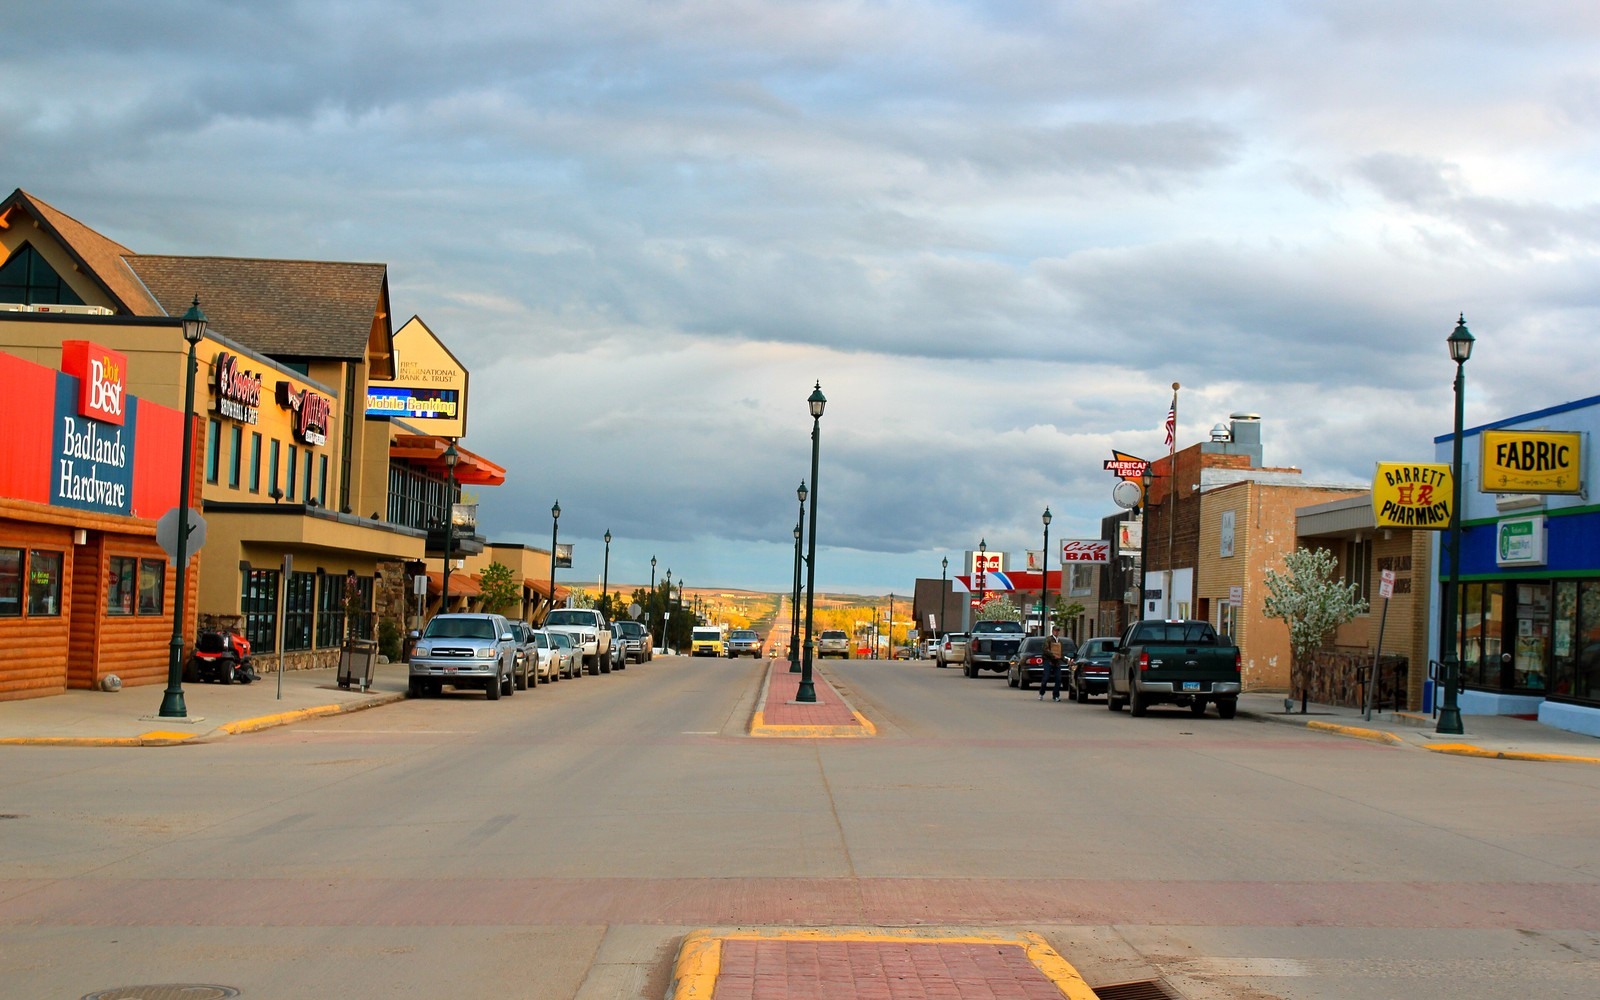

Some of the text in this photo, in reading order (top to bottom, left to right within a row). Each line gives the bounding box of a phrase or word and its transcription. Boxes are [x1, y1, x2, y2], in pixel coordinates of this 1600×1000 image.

[89, 358, 122, 416] Best
[431, 375, 453, 383] TRUST
[366, 395, 456, 416] Mobile Banking
[63, 416, 126, 468] Badlands
[1496, 440, 1570, 472] FABRIC
[58, 458, 126, 508] Hardware
[1117, 469, 1144, 477] LEGIO
[1385, 467, 1446, 487] BARRETT
[1380, 499, 1450, 526] PHARMACY
[1063, 541, 1109, 554] City
[1065, 552, 1107, 561] BAR
